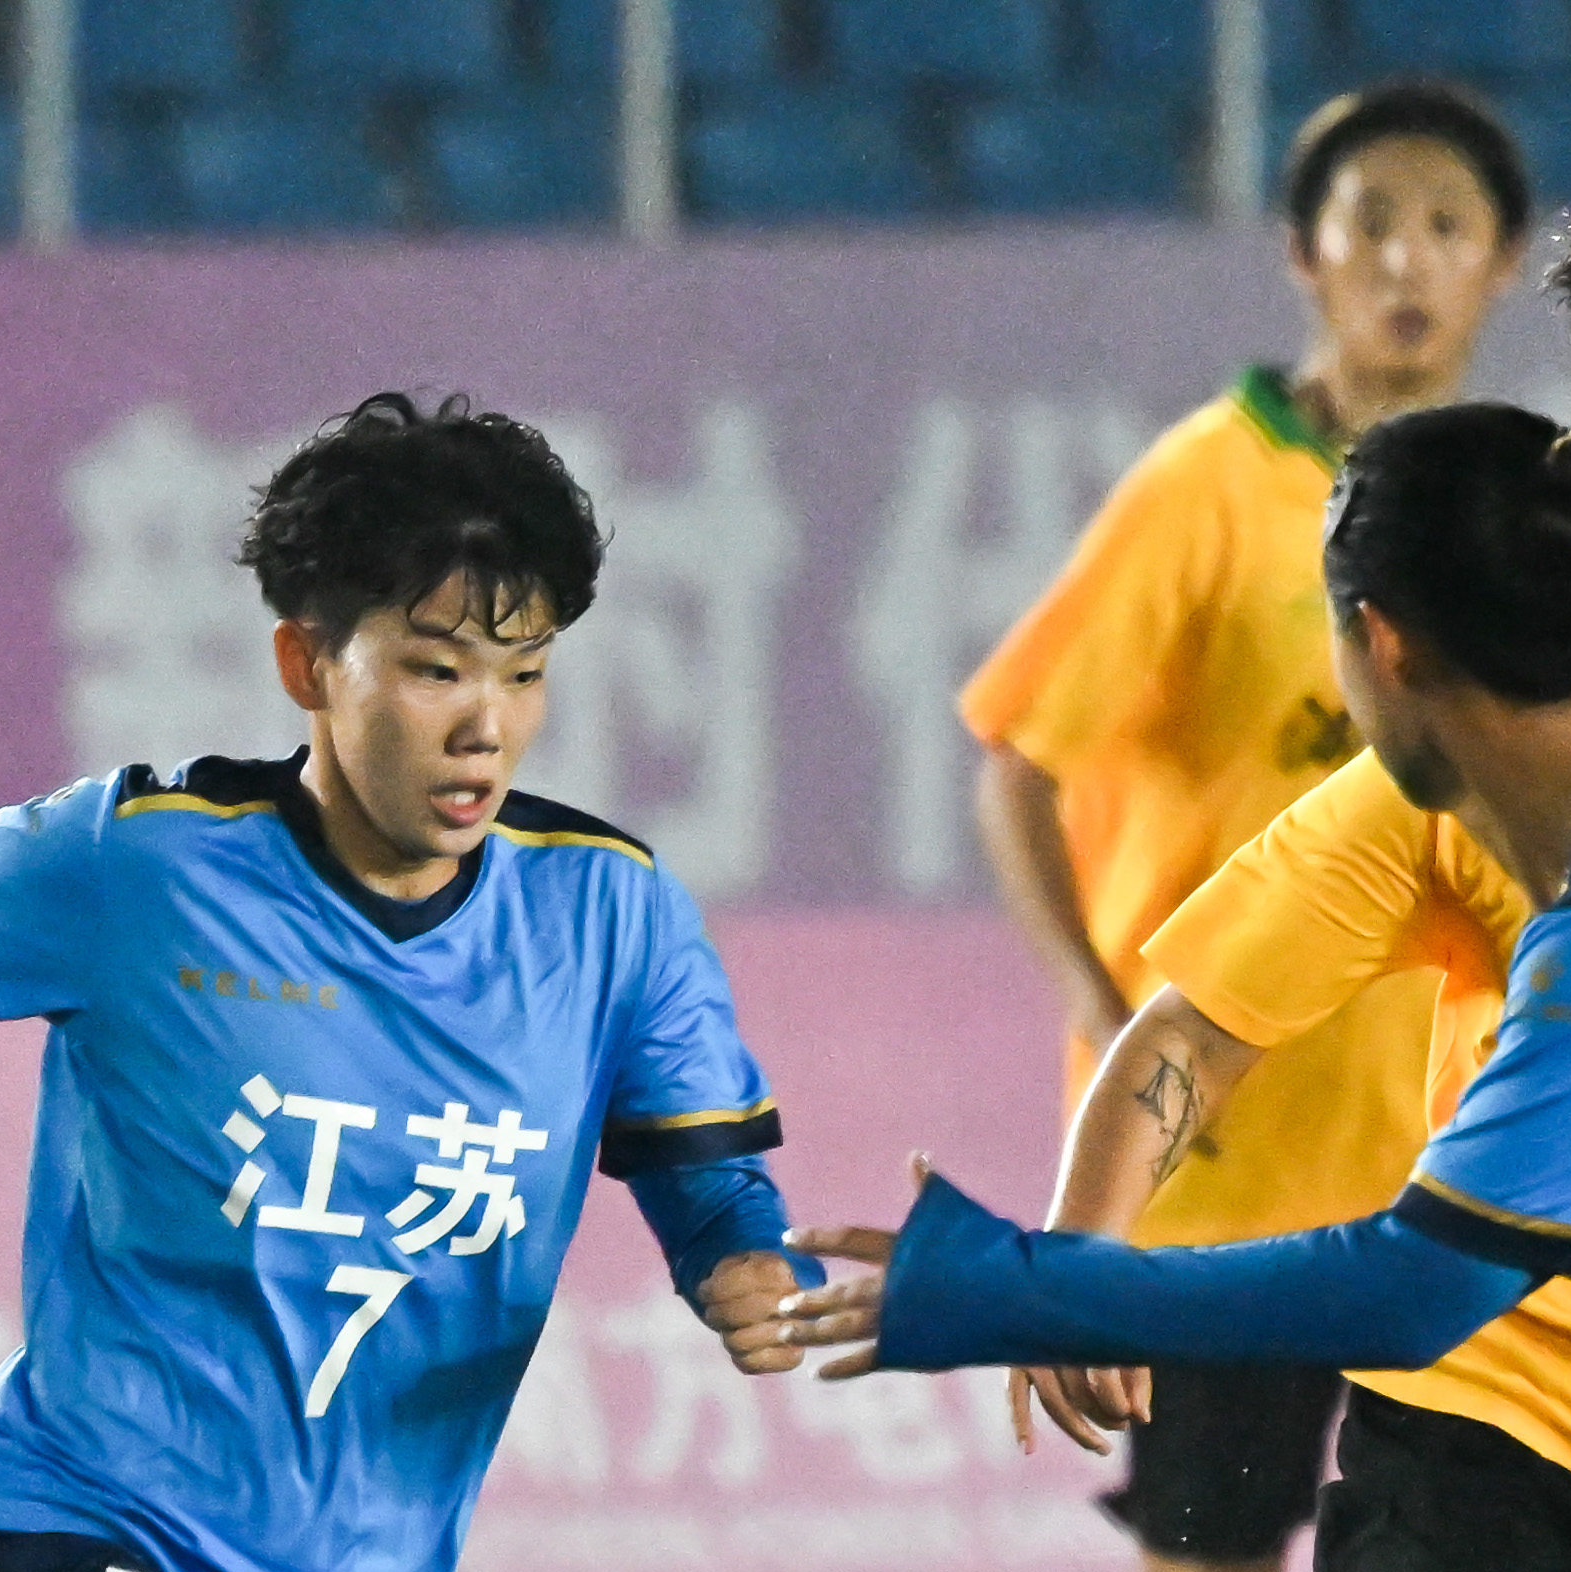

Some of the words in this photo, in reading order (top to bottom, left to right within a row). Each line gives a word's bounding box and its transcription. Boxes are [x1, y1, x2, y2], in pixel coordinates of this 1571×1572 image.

[179, 966, 340, 1012] KELME
[220, 1072, 549, 1256] 江苏
[305, 1264, 416, 1418] 7
